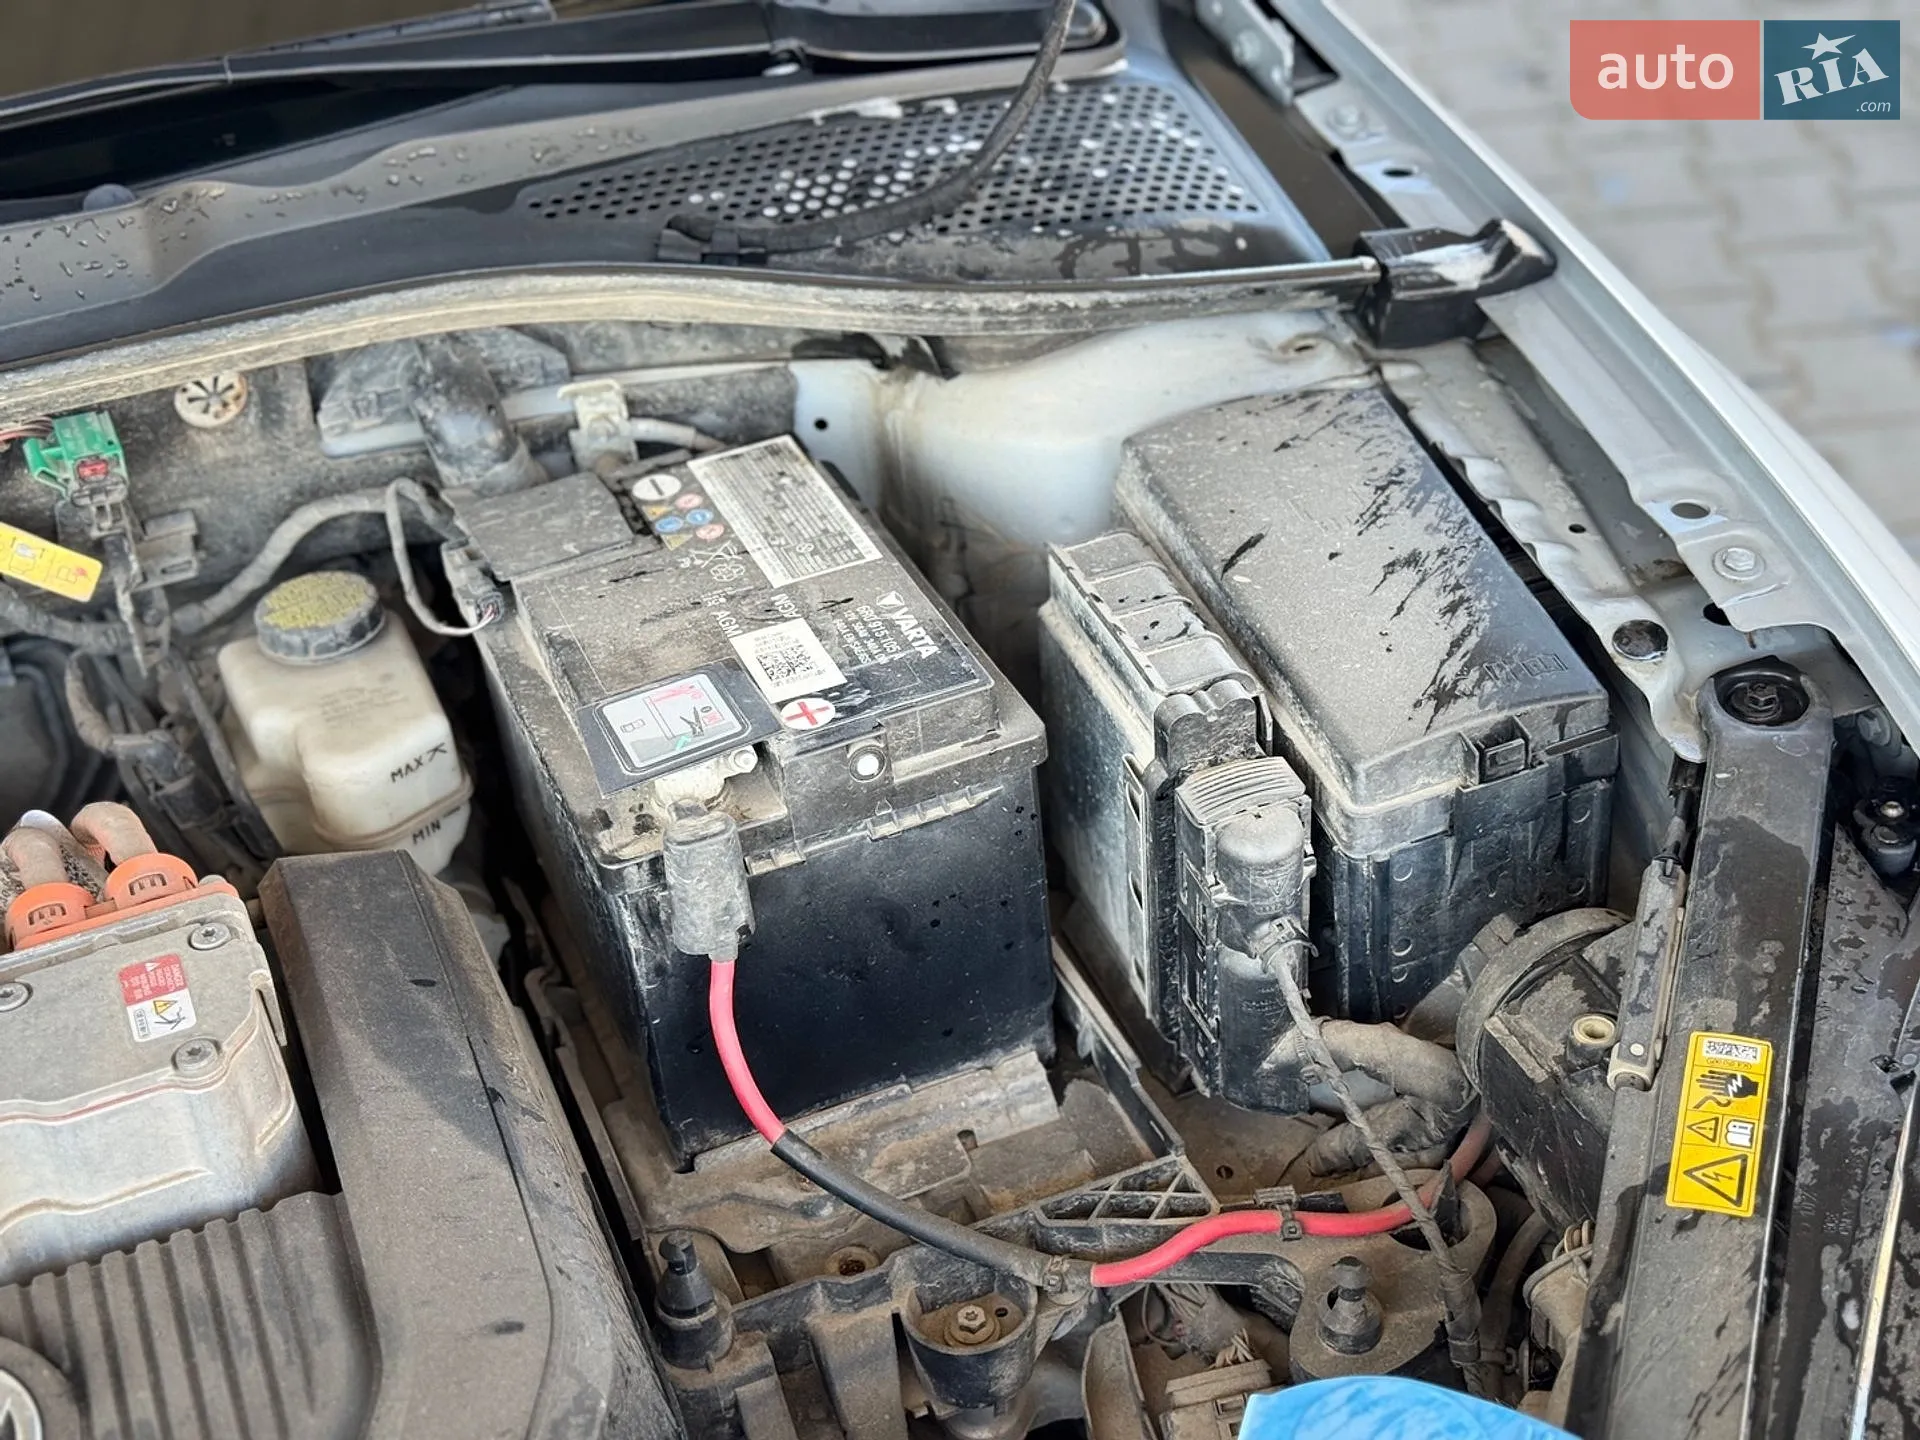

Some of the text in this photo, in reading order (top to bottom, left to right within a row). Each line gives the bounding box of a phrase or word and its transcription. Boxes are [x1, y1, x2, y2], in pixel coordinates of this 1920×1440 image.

[710, 610, 743, 638] AGM
[867, 620, 889, 637] 915
[879, 637, 902, 653] 105
[891, 606, 940, 659] VARTA
[390, 755, 424, 783] MAX
[412, 819, 442, 845] MIN
